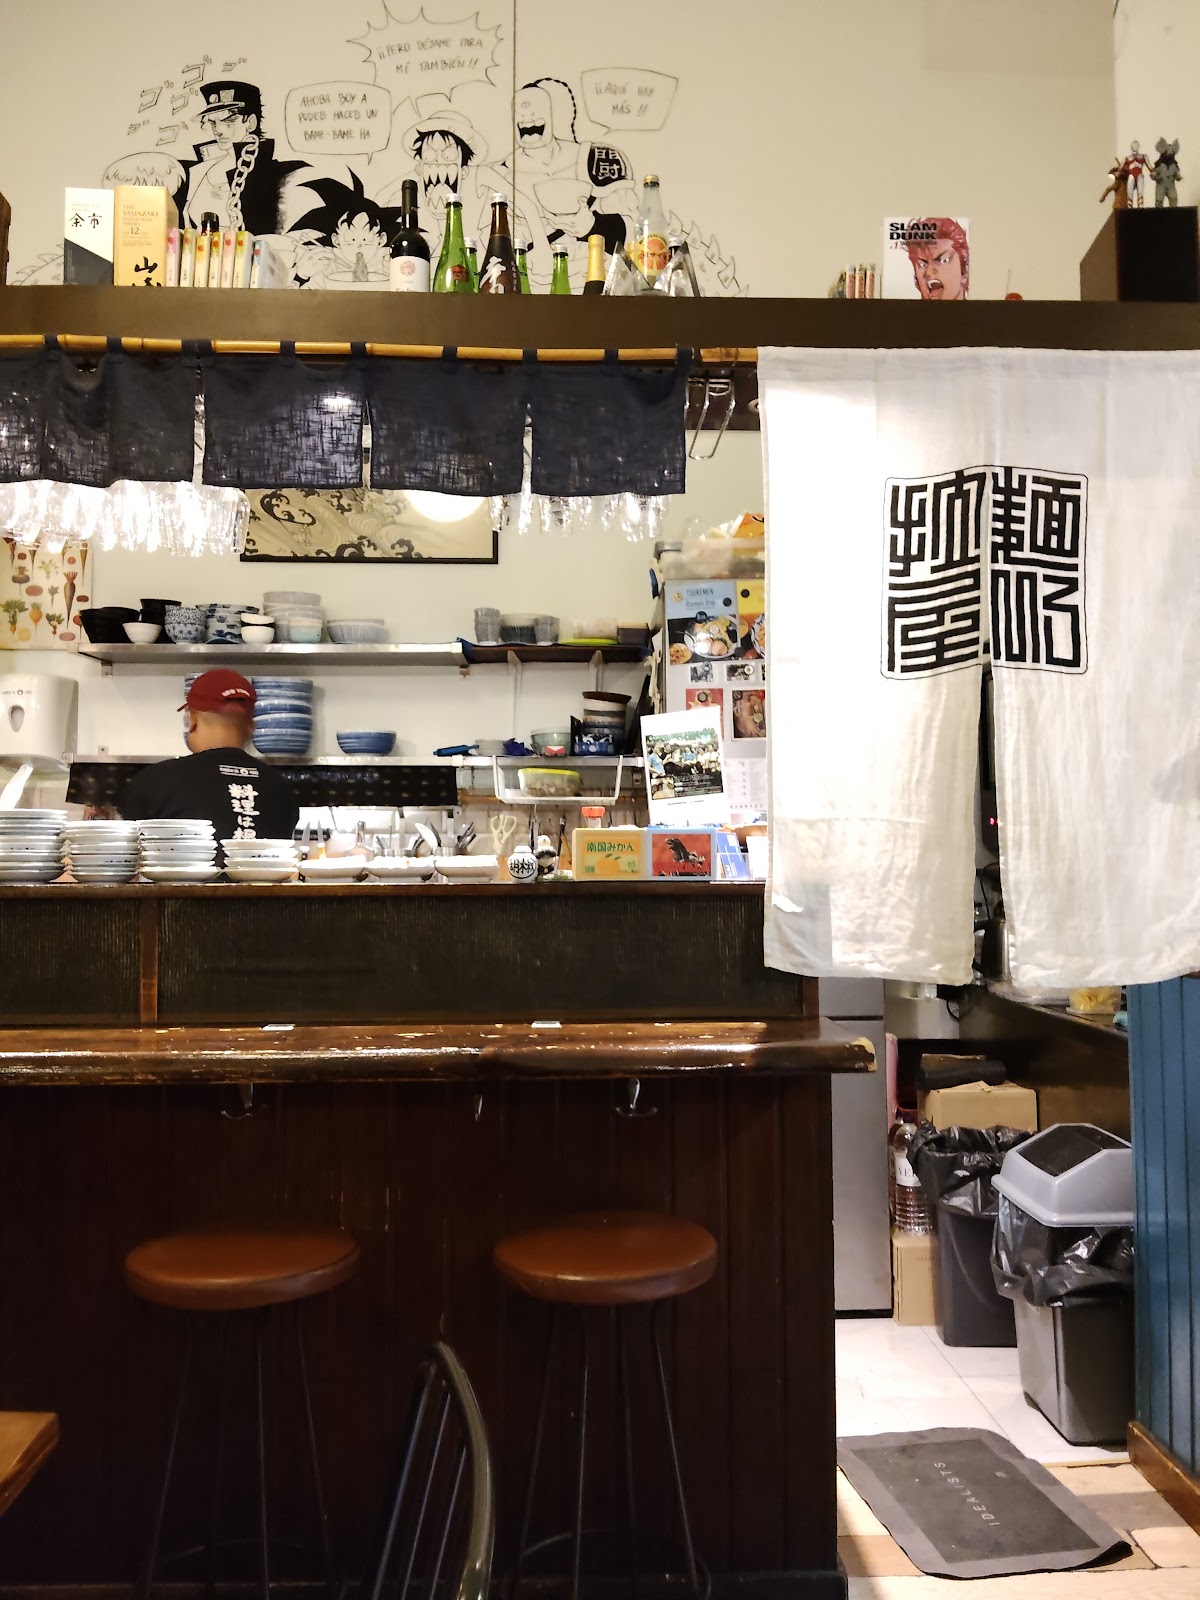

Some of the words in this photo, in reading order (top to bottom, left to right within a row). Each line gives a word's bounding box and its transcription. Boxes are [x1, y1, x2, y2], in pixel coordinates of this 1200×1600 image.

[416, 37, 450, 50] DÉJAME
[459, 37, 483, 48] PARA
[395, 61, 411, 74] MÍ
[637, 86, 655, 96] HAY
[360, 93, 368, 104] A
[366, 109, 378, 119] UN
[360, 129, 371, 139] HA
[130, 226, 140, 235] 12
[889, 222, 938, 231] SLAM
[889, 232, 937, 240] DUNK
[686, 587, 714, 597] TSUKEMEN
[586, 841, 635, 853] 南国みかん
[933, 1462, 1001, 1526] IDEALISTS
